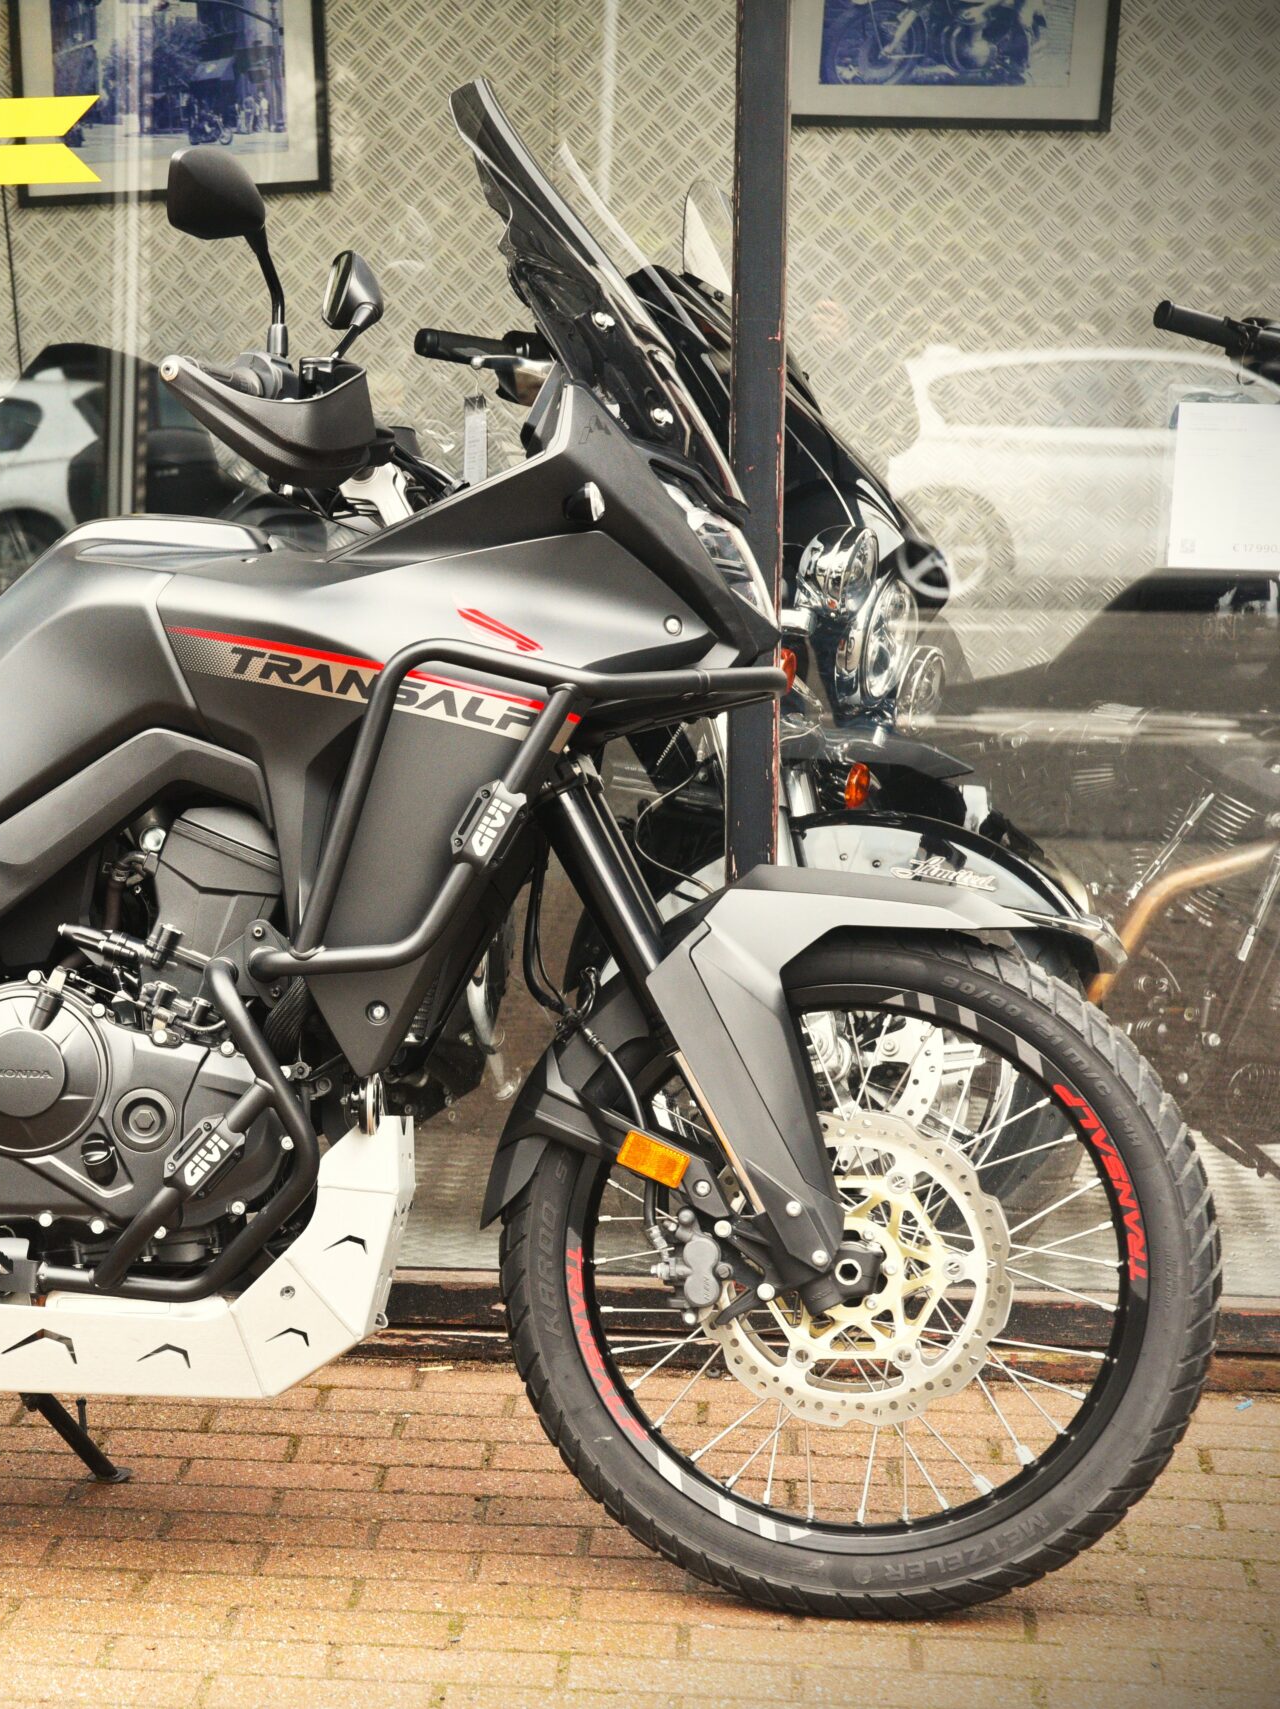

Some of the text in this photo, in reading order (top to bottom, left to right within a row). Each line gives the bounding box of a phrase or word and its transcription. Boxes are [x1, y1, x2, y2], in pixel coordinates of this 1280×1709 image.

[231, 647, 539, 731] TRANSALP
[471, 798, 513, 857] GIVI
[890, 856, 997, 892] Limited
[183, 1133, 230, 1186] GIVI
[1052, 1084, 1148, 1281] TRANSALP
[883, 1511, 1051, 1583] METZELER
